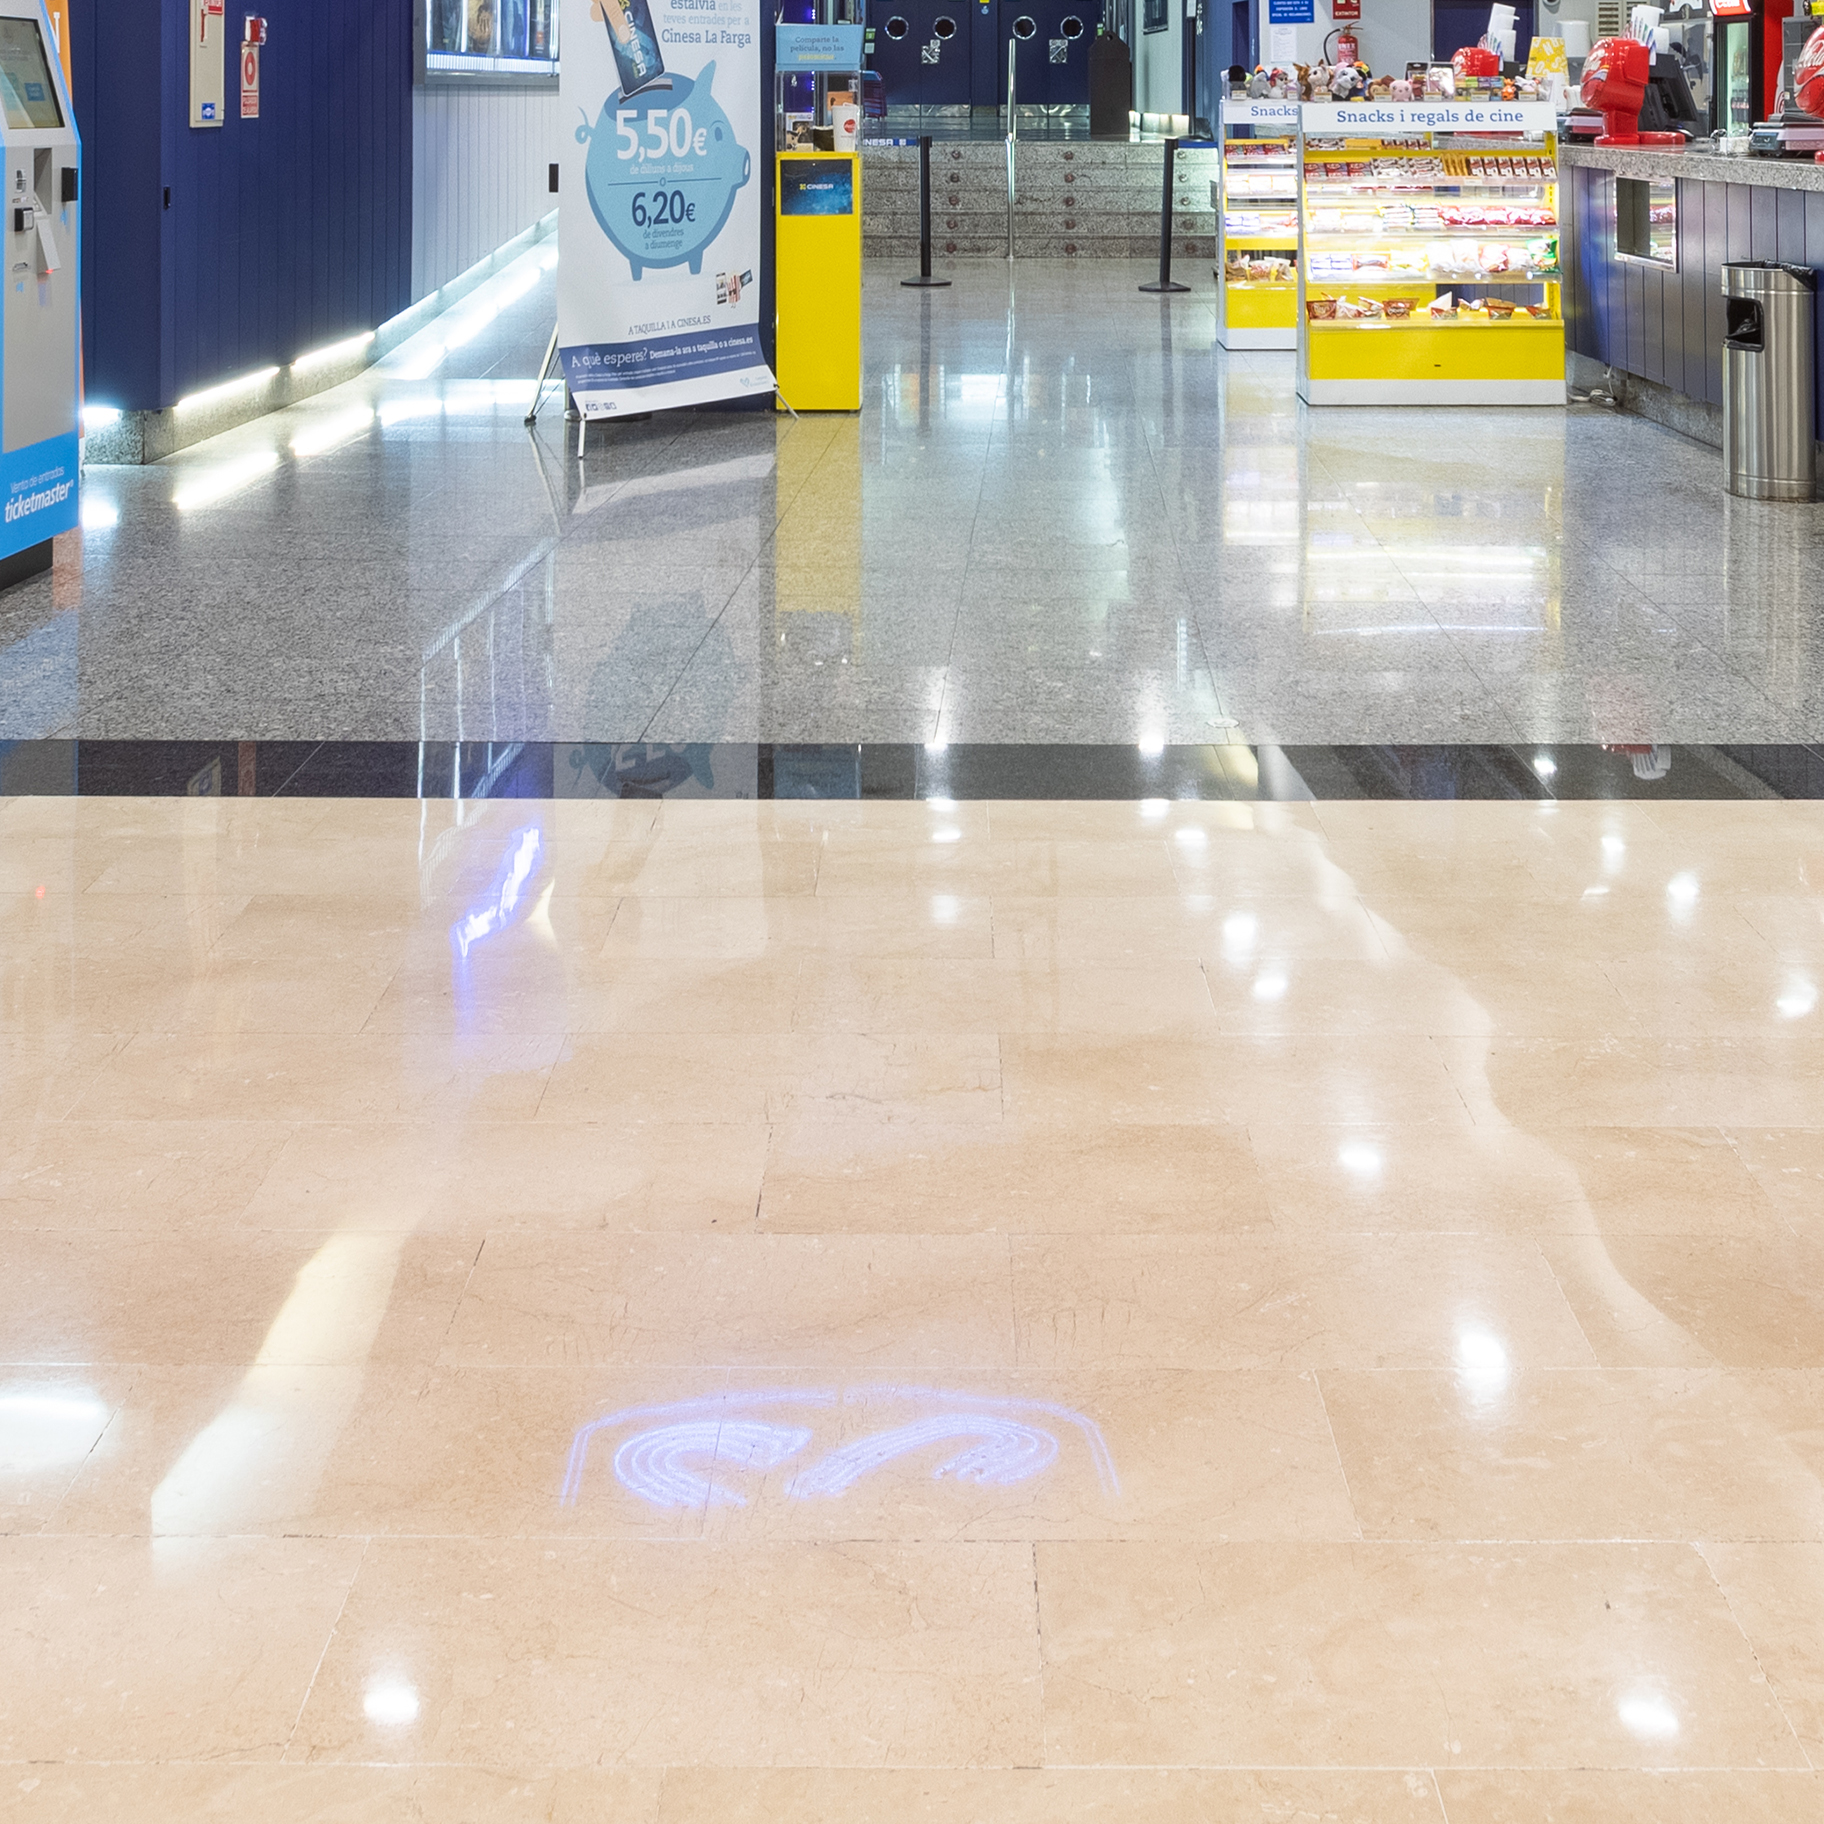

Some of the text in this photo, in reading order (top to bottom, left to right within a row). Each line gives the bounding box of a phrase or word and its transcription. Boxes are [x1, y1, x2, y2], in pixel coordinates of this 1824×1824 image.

[623, 11, 647, 78] CINESA
[661, 28, 752, 48] Cinesa La Farga
[795, 36, 830, 45] Comparte
[1251, 105, 1298, 118] Snacks
[1336, 108, 1524, 128] Snacks i regals de cine
[616, 107, 708, 163] 5,50€
[631, 190, 696, 230] 6,20€
[634, 322, 666, 336] TAQUILLA
[571, 355, 581, 369] A
[582, 353, 602, 370] què
[603, 347, 650, 368] esperes?
[10, 466, 66, 494] Venta de entradas
